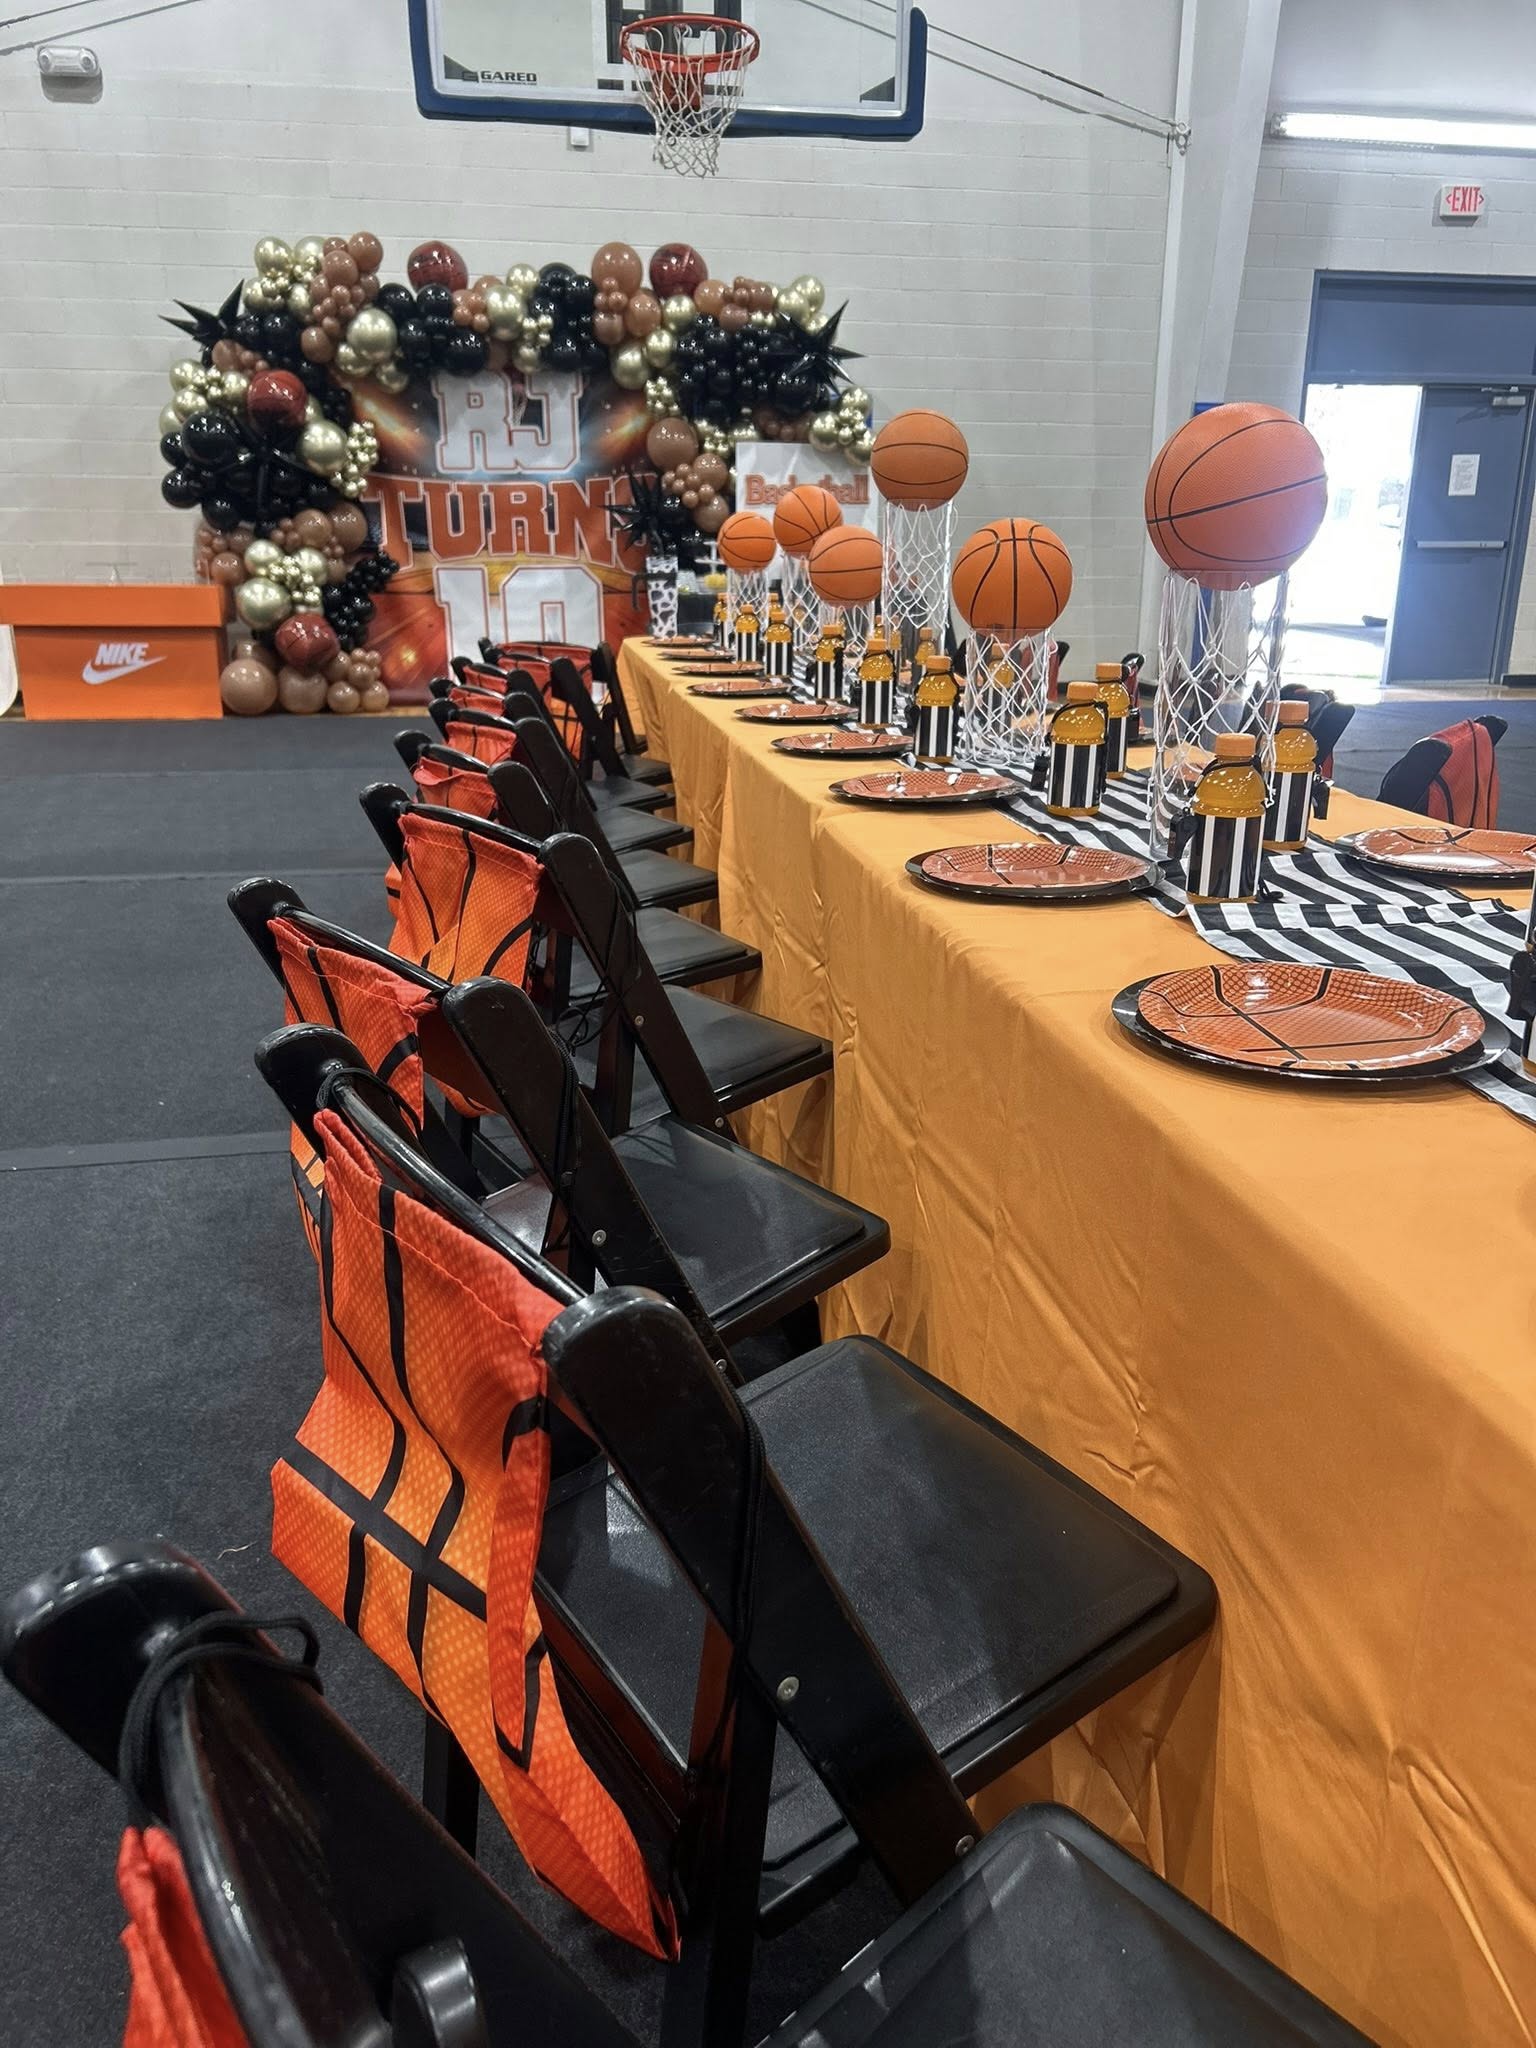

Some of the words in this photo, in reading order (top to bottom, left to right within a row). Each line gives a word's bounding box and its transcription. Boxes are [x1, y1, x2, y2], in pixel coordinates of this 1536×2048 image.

[480, 70, 537, 82] GARED
[1451, 186, 1481, 212] EXIT
[430, 371, 584, 473] RJ
[744, 473, 870, 505] Basball
[95, 642, 149, 665] NIKE
